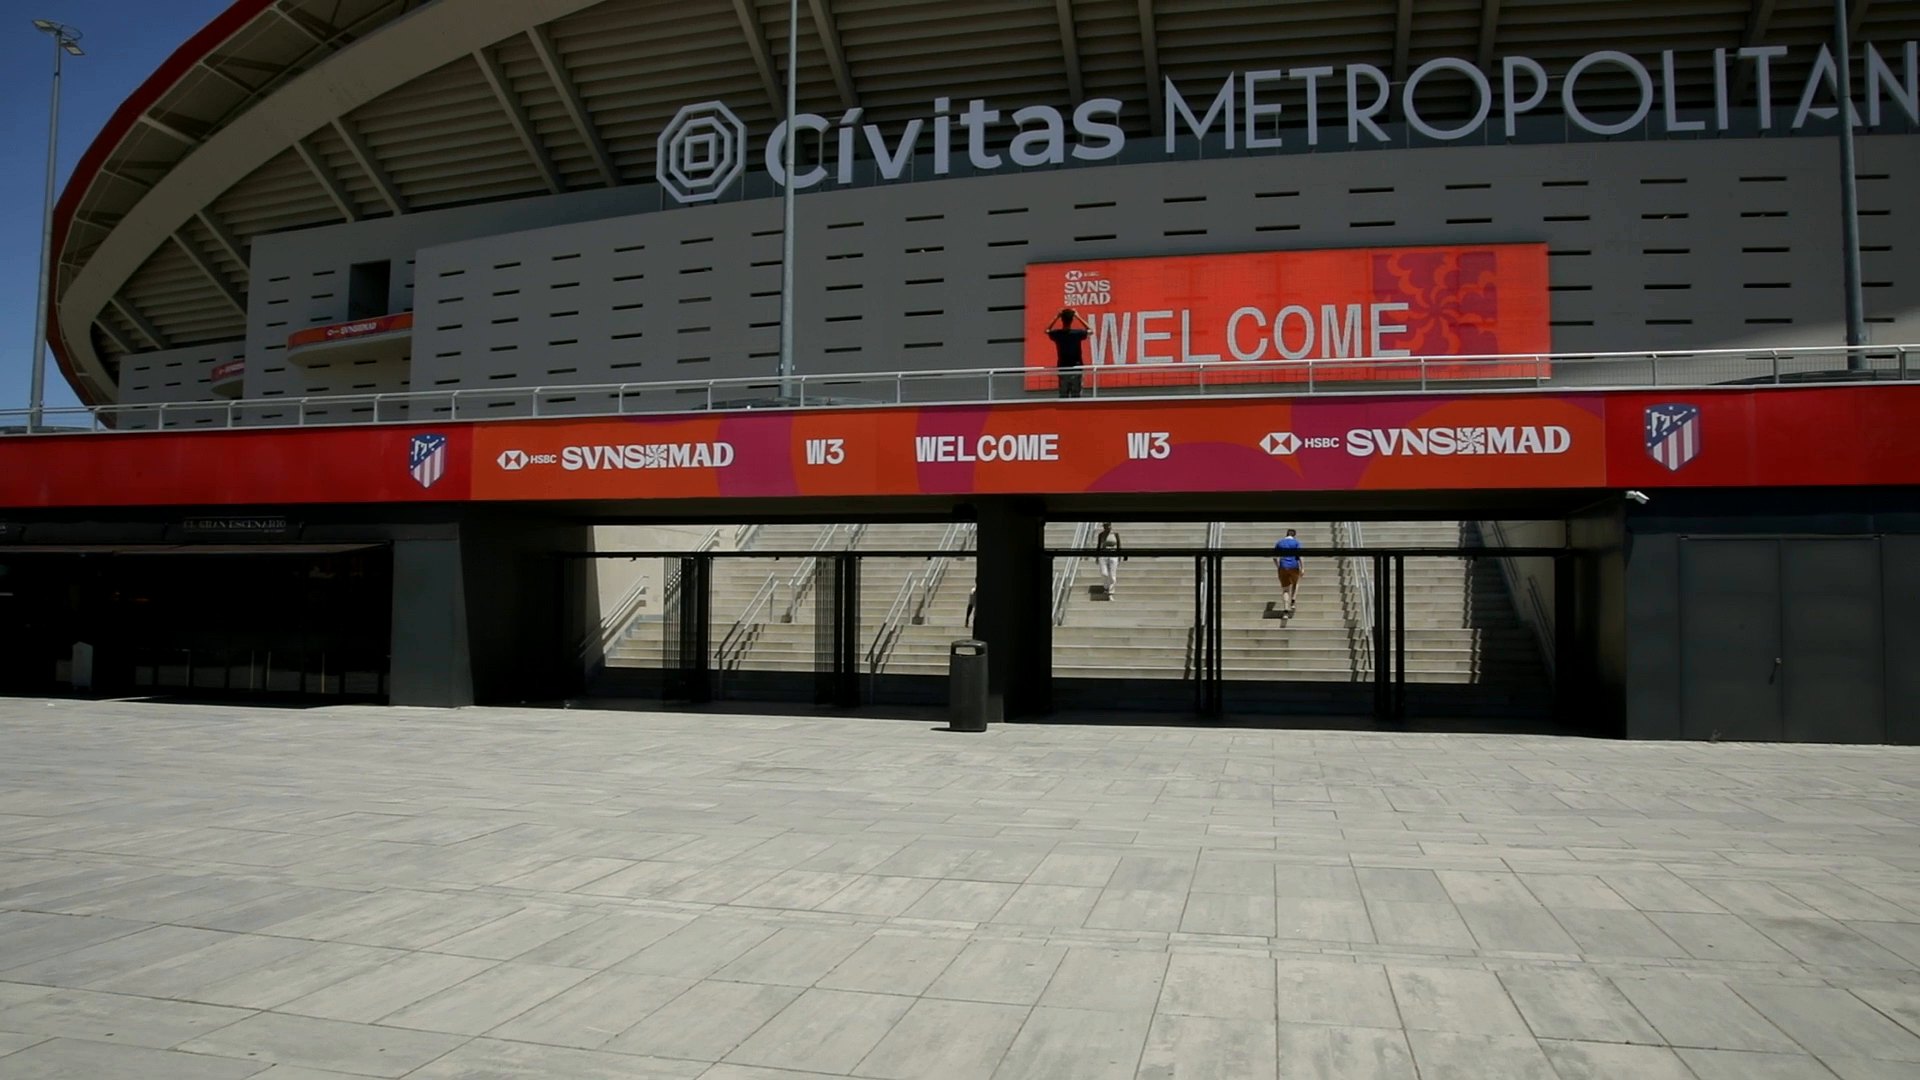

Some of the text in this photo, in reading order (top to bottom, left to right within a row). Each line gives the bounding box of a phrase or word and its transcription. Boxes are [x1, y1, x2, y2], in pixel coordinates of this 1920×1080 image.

[765, 41, 1920, 189] Cívitas METROPOLITAN
[1064, 280, 1111, 294] SVNS
[1076, 292, 1111, 306] MAD
[1087, 302, 1411, 367] WELCOME
[806, 438, 845, 465] W3
[915, 433, 1059, 463] WELCOME
[1126, 431, 1171, 459] W3
[1304, 437, 1339, 449] HSBC
[530, 454, 557, 464] HSBC
